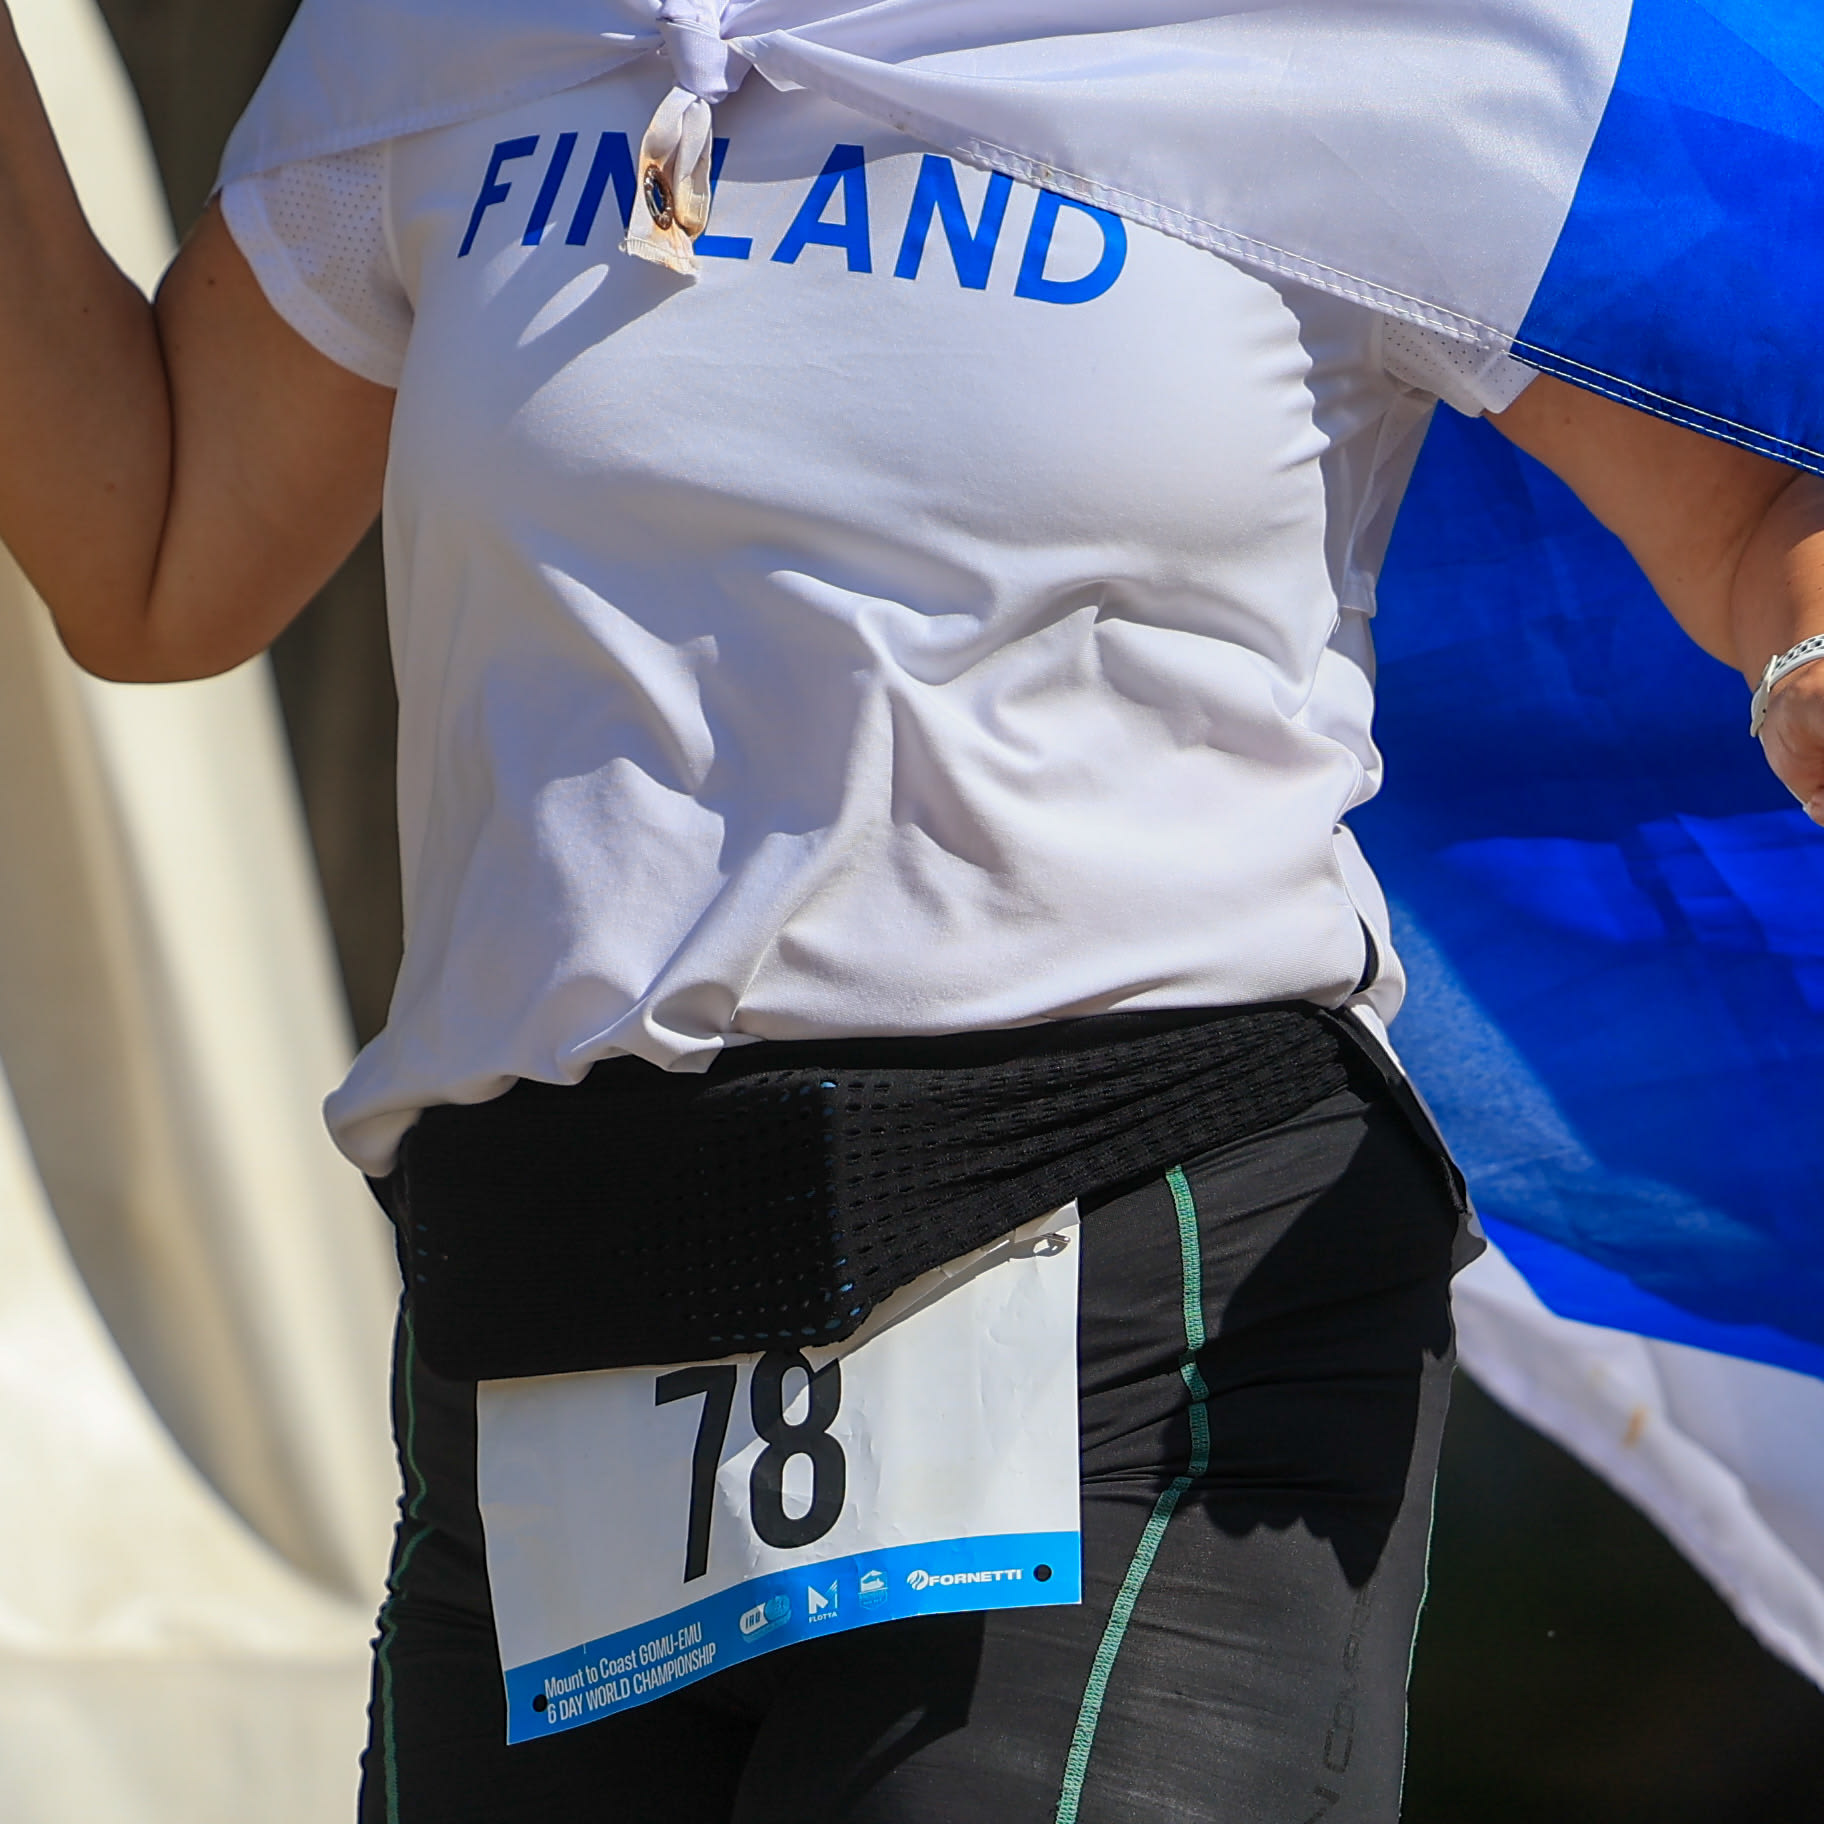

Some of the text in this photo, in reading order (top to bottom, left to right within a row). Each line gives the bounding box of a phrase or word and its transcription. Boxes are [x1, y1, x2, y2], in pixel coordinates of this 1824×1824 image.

[655, 1349, 846, 1583] 78
[929, 1569, 1022, 1586] FORNETTI
[809, 1611, 838, 1623] FLOTTA
[544, 1622, 702, 1699] Mount to Coast GOMU-EMU
[547, 1642, 716, 1724] 6 DAY WORLD CHAMPIONSHIP
